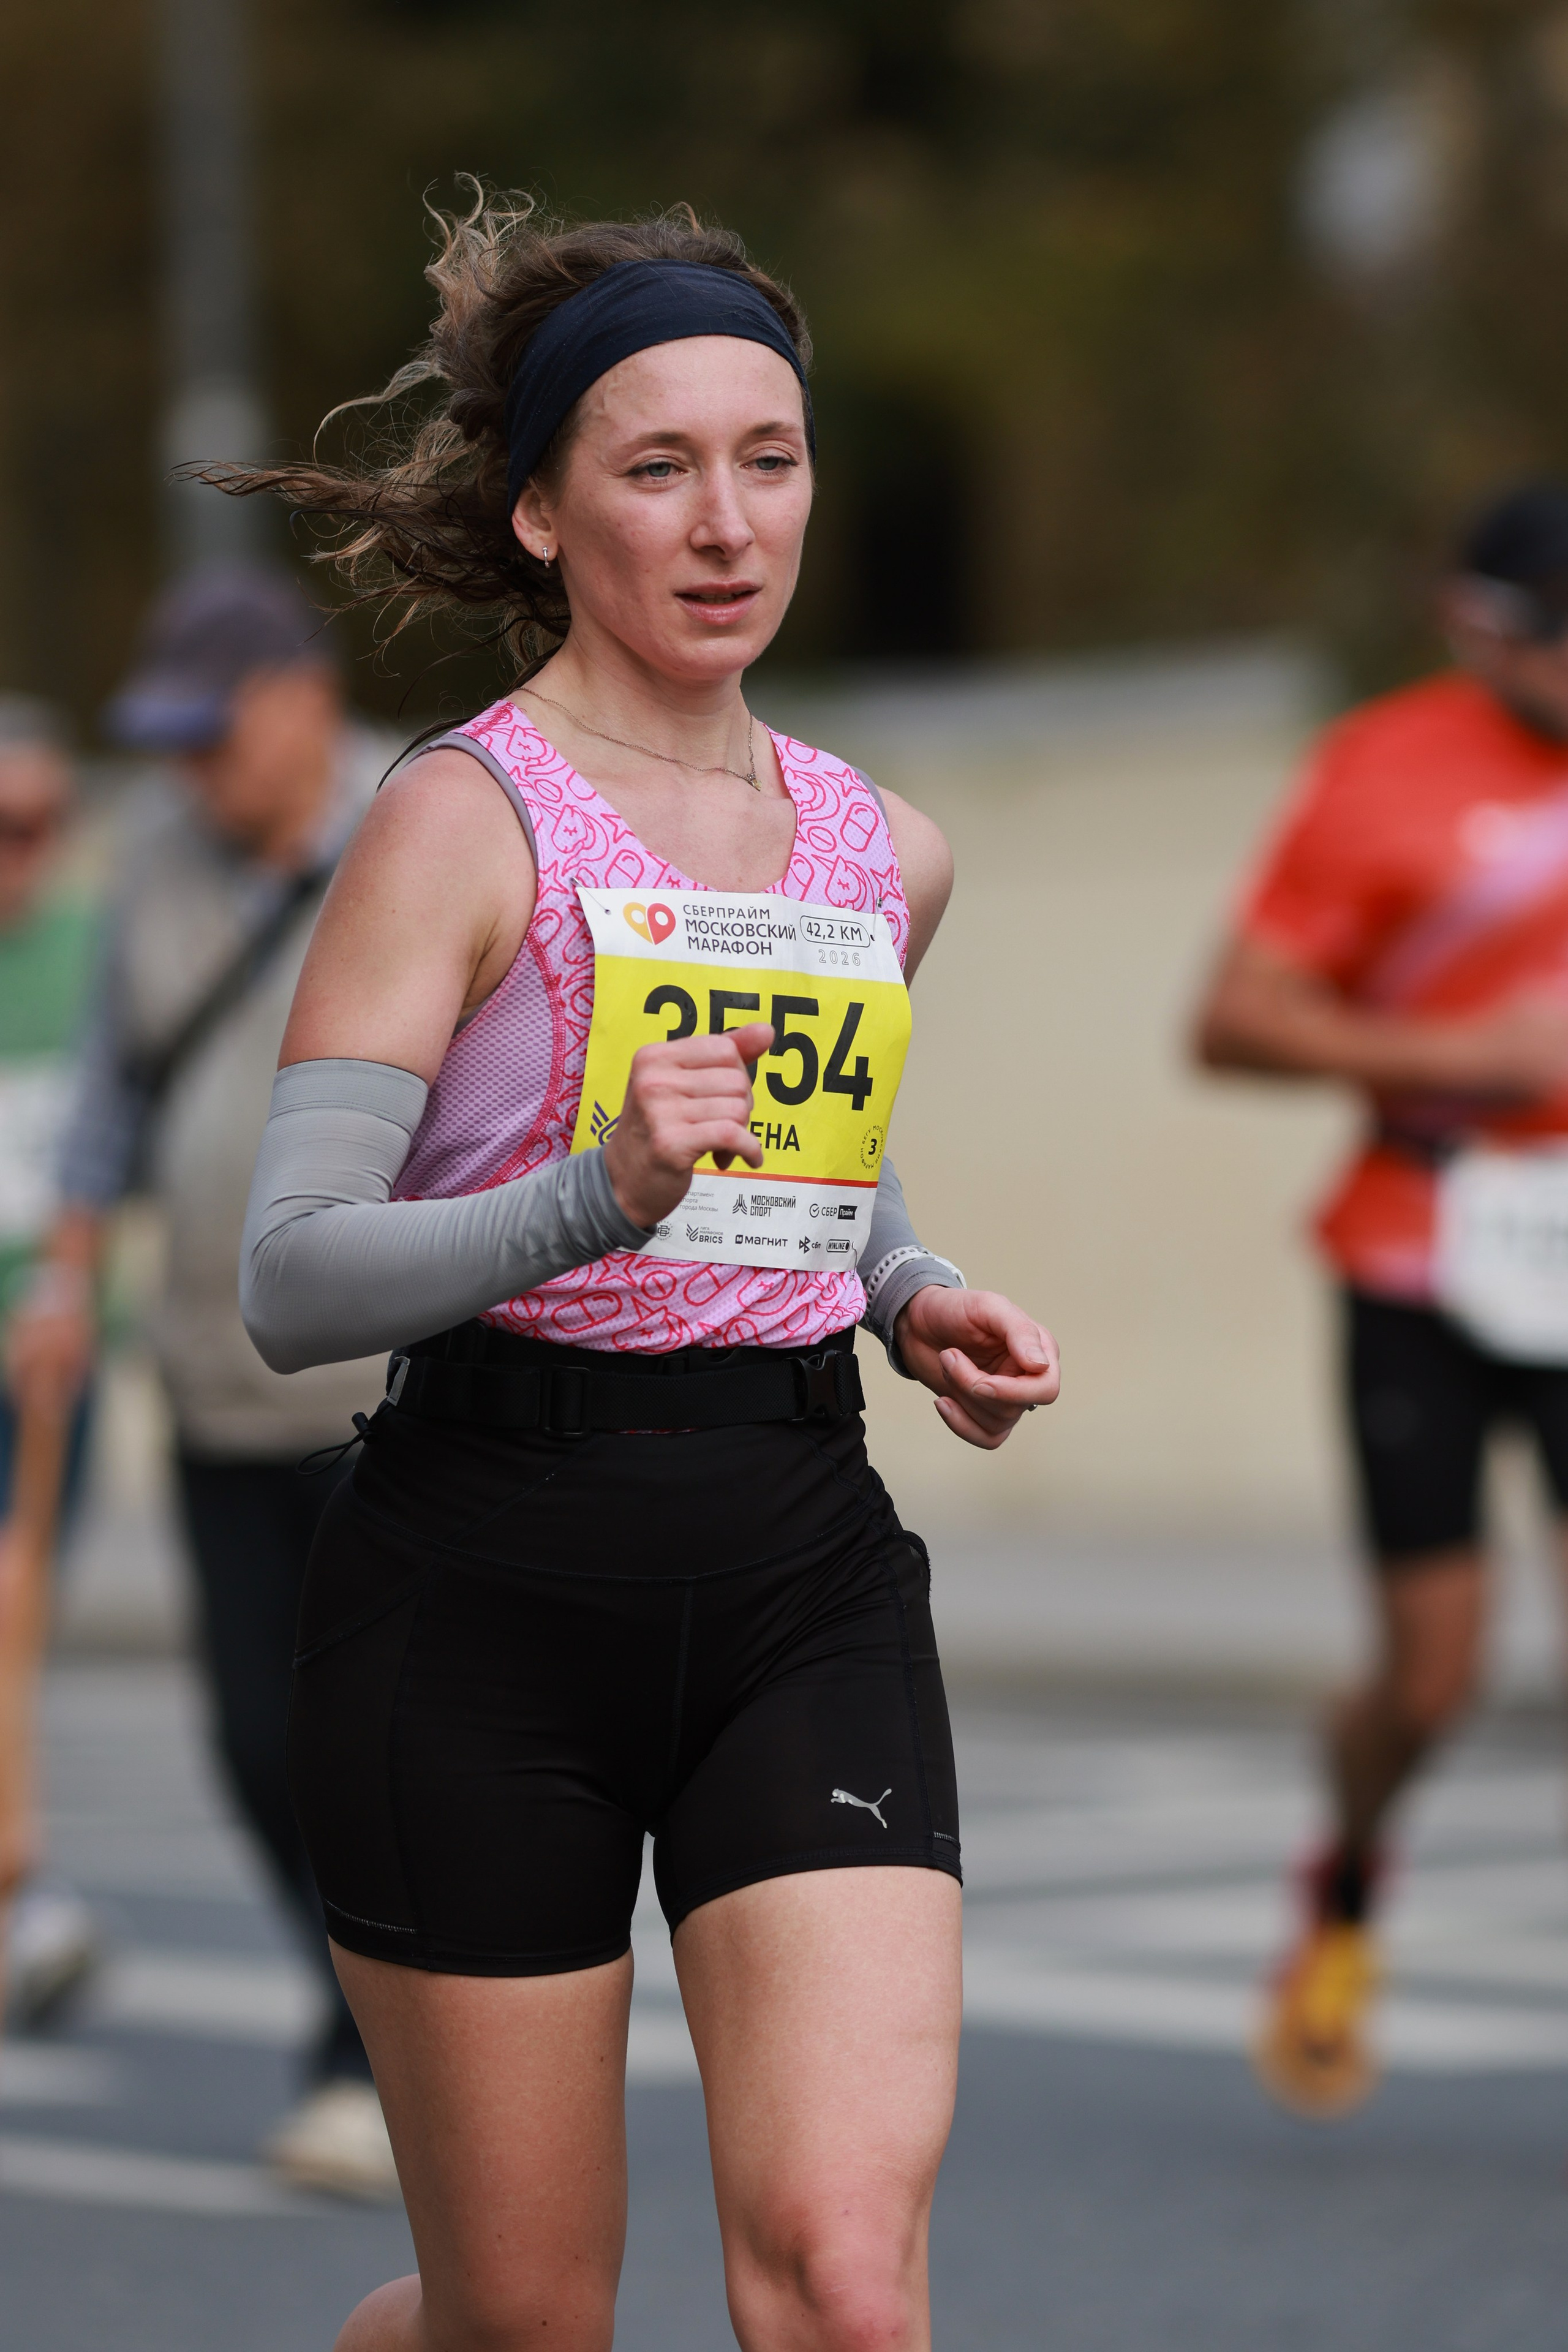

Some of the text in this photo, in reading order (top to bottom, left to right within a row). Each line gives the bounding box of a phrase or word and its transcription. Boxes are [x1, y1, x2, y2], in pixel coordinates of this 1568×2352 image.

[683, 904, 771, 919] СБЕРПРАЙМ
[685, 919, 796, 941] МОСКОВСКИЙ
[807, 922, 862, 941] 42,2 КМ
[687, 936, 772, 956] МАРАФОН
[818, 949, 861, 966] 2026
[750, 1121, 801, 1152] ЕНА
[868, 1138, 878, 1155] 3
[750, 1195, 796, 1208] МОСКОВСКИЙ
[750, 1206, 772, 1217] СПОРТ
[821, 1207, 853, 1217] СБЕР Прайм
[699, 1235, 723, 1244] BRICS
[745, 1236, 788, 1247] магнит
